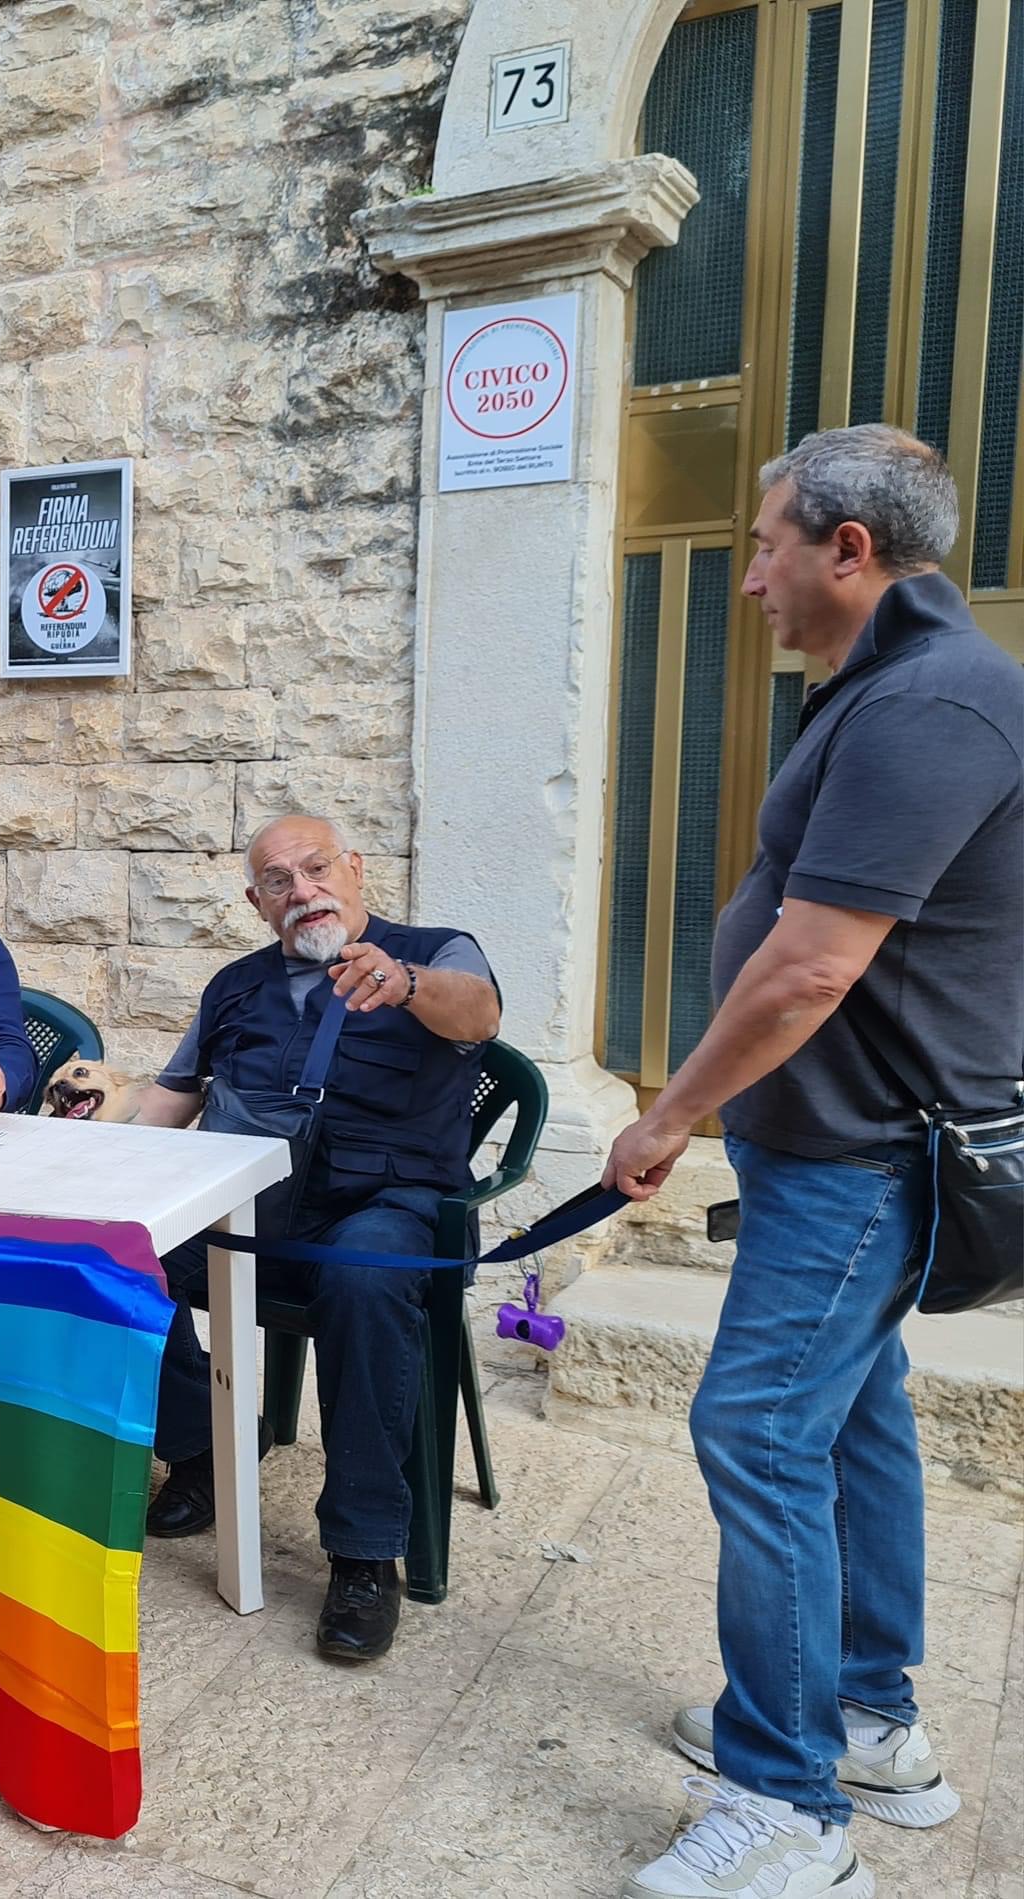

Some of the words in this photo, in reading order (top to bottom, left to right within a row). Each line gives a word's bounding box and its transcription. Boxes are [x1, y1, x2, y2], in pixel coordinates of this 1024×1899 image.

[502, 62, 556, 116] 73
[464, 362, 549, 391] CIVICO
[477, 388, 534, 414] 2050
[37, 494, 89, 526] FIRMA
[11, 519, 119, 556] REFERENDUM
[40, 621, 88, 632] REFERENDUM
[47, 629, 80, 639] RIPUDIA
